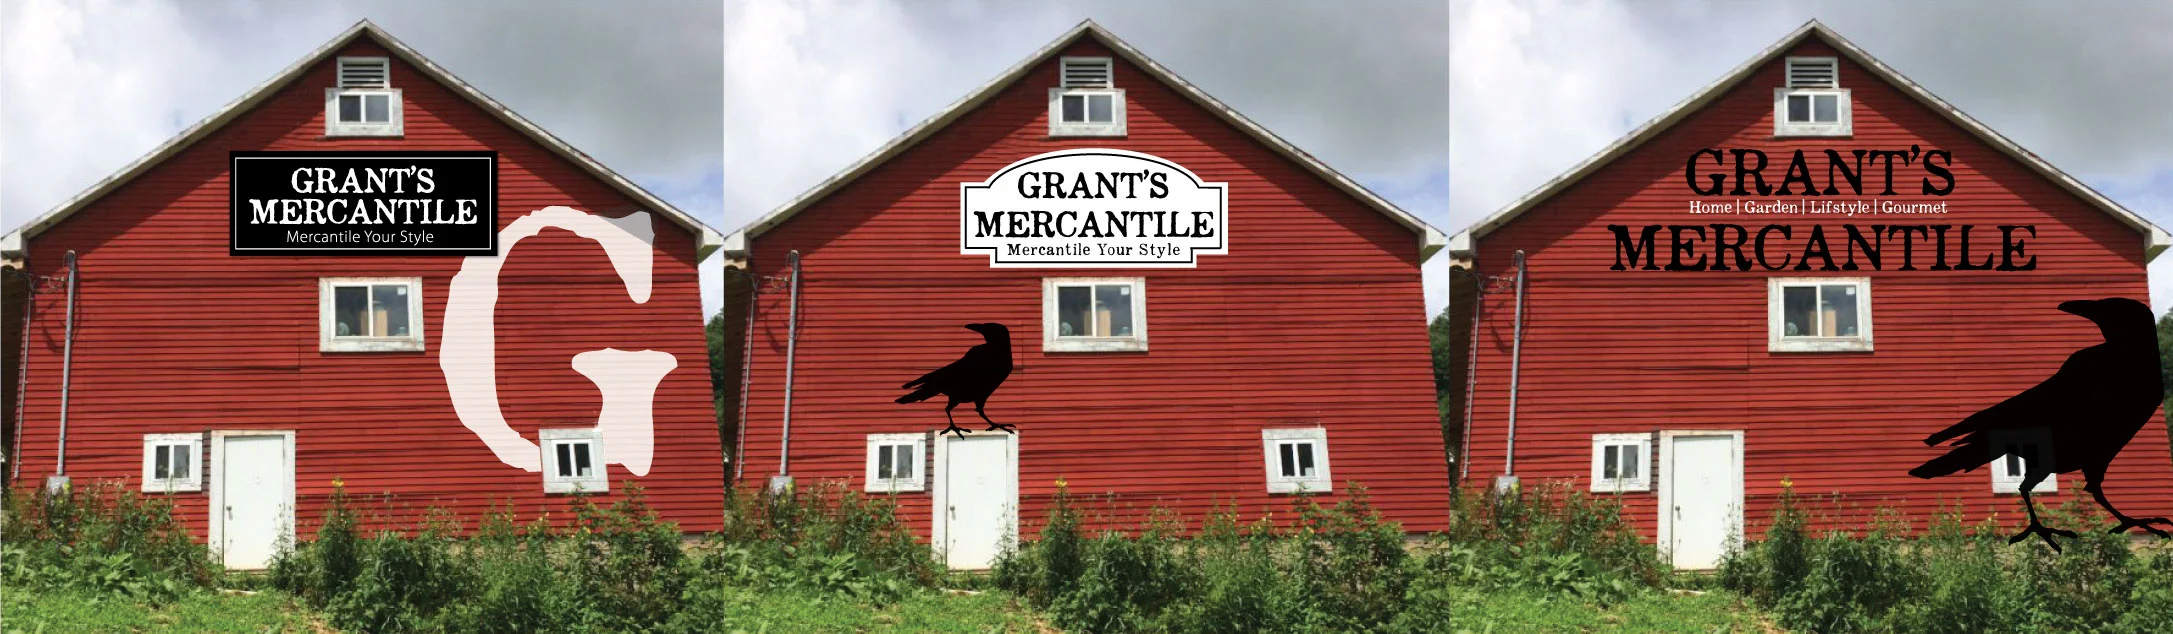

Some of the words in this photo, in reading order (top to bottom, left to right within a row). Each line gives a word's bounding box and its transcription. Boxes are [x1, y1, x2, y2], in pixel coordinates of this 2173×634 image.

[291, 165, 436, 194] GRANT'S
[1017, 169, 1169, 199] GRANT'S
[1685, 145, 1956, 197] GRANT'S
[249, 199, 478, 225] MERCANTILE
[1689, 200, 1732, 215] Home
[1744, 199, 1799, 215] Garden
[1810, 199, 1871, 217] Lifstyle
[1882, 200, 1948, 215] Gourmet
[286, 230, 361, 243] Mercantile
[364, 230, 396, 243] Your
[400, 230, 434, 246] Style
[973, 210, 1214, 238] MERCANTILE
[1007, 243, 1091, 256] Mercantile
[1097, 243, 1133, 256] Your
[1139, 243, 1181, 258] Style
[1607, 223, 2038, 272] MERCANTILE
